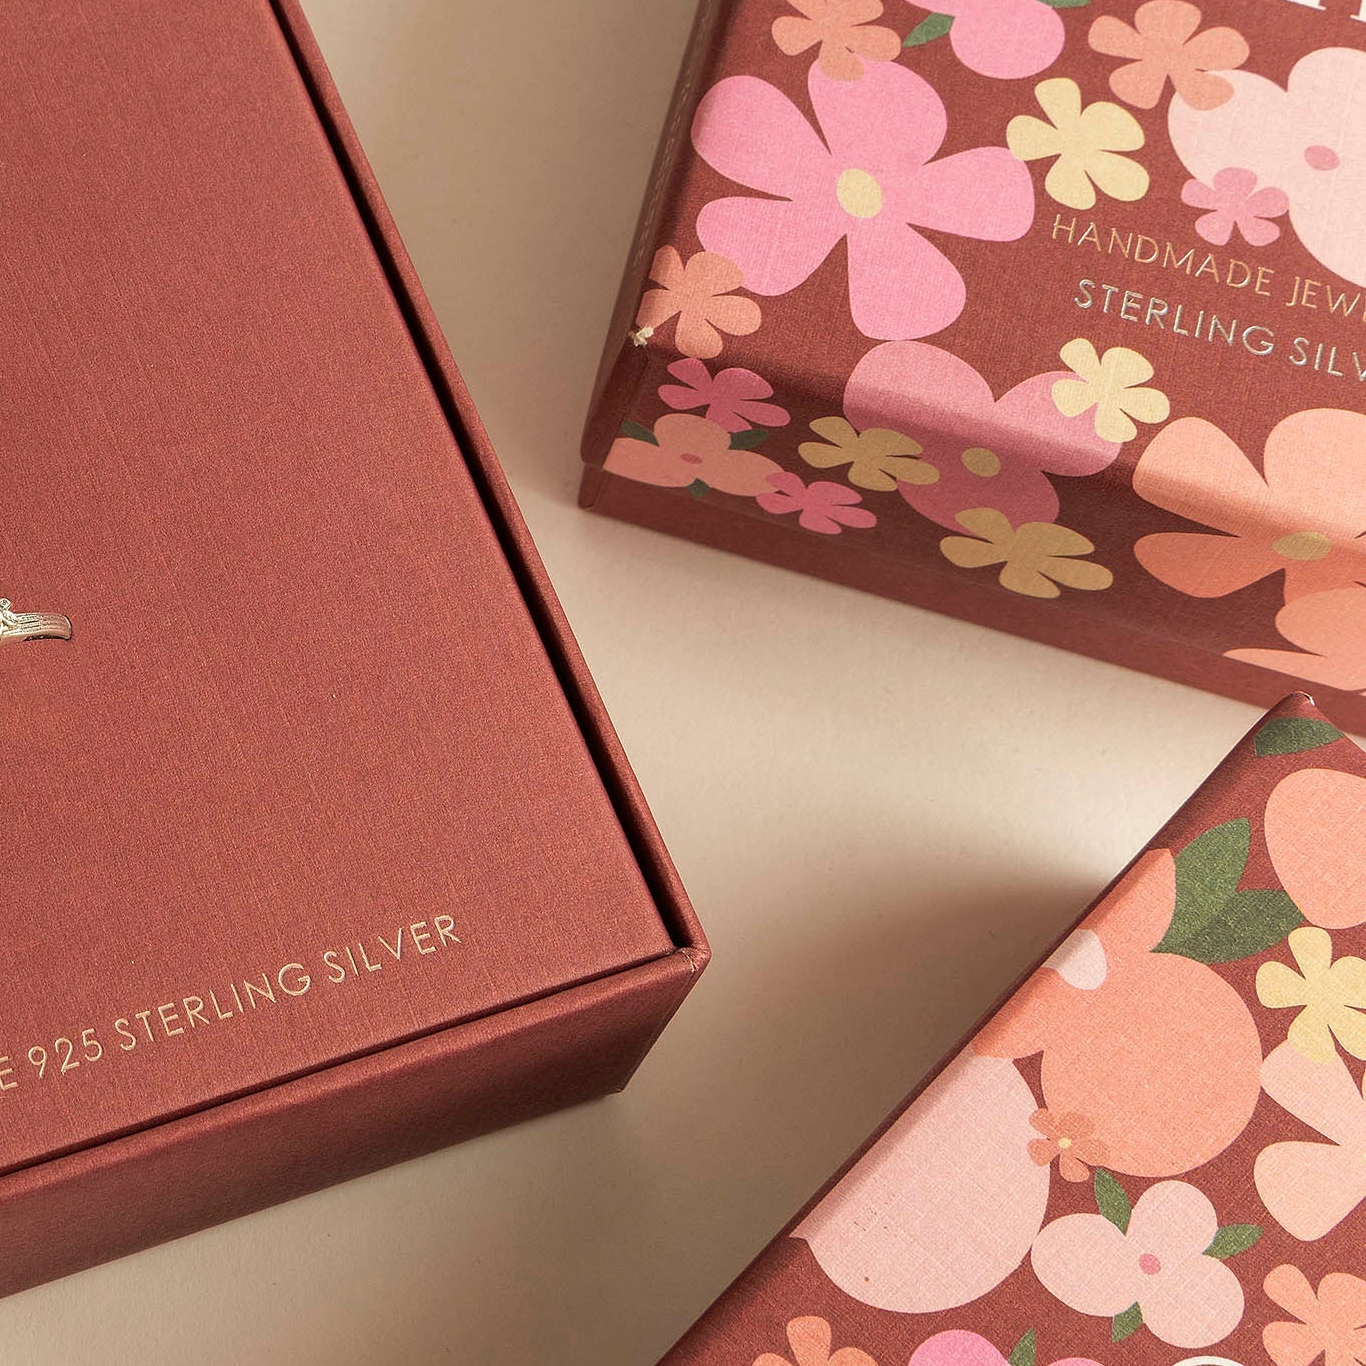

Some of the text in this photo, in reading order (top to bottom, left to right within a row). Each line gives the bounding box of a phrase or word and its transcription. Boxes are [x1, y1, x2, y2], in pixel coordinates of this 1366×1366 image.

[1051, 213, 1366, 322] HANDMADE JEW
[1073, 278, 1276, 357] STERLING
[27, 1028, 105, 1080] 925
[114, 962, 313, 1052] STERLING
[323, 913, 463, 985] SILVER
